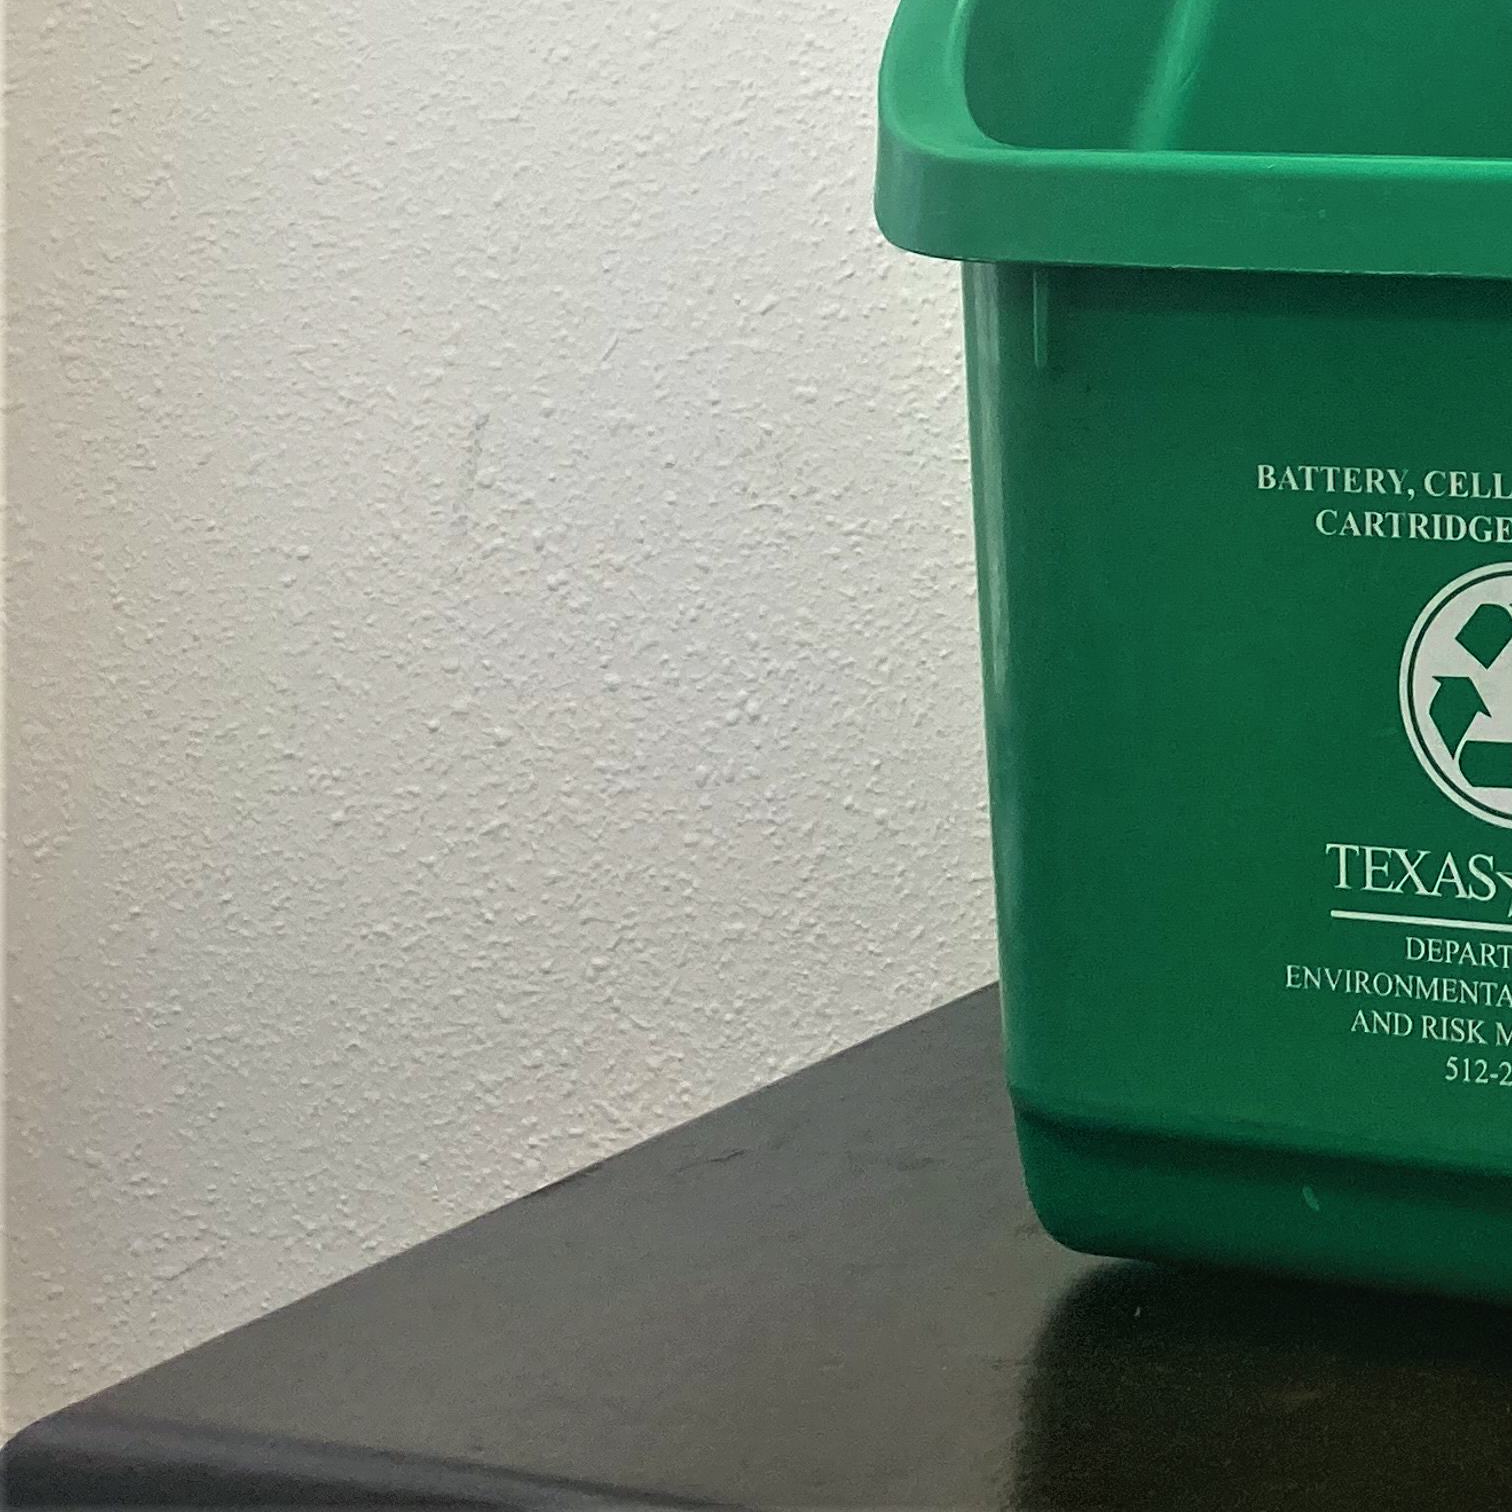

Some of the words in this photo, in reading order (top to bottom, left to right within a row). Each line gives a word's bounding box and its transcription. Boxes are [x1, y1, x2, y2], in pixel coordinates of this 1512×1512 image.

[1257, 464, 1416, 501] BATTERY,
[1325, 843, 1497, 902] TEXAS
[1351, 1009, 1413, 1037] AND
[1421, 1014, 1488, 1045] RISK
